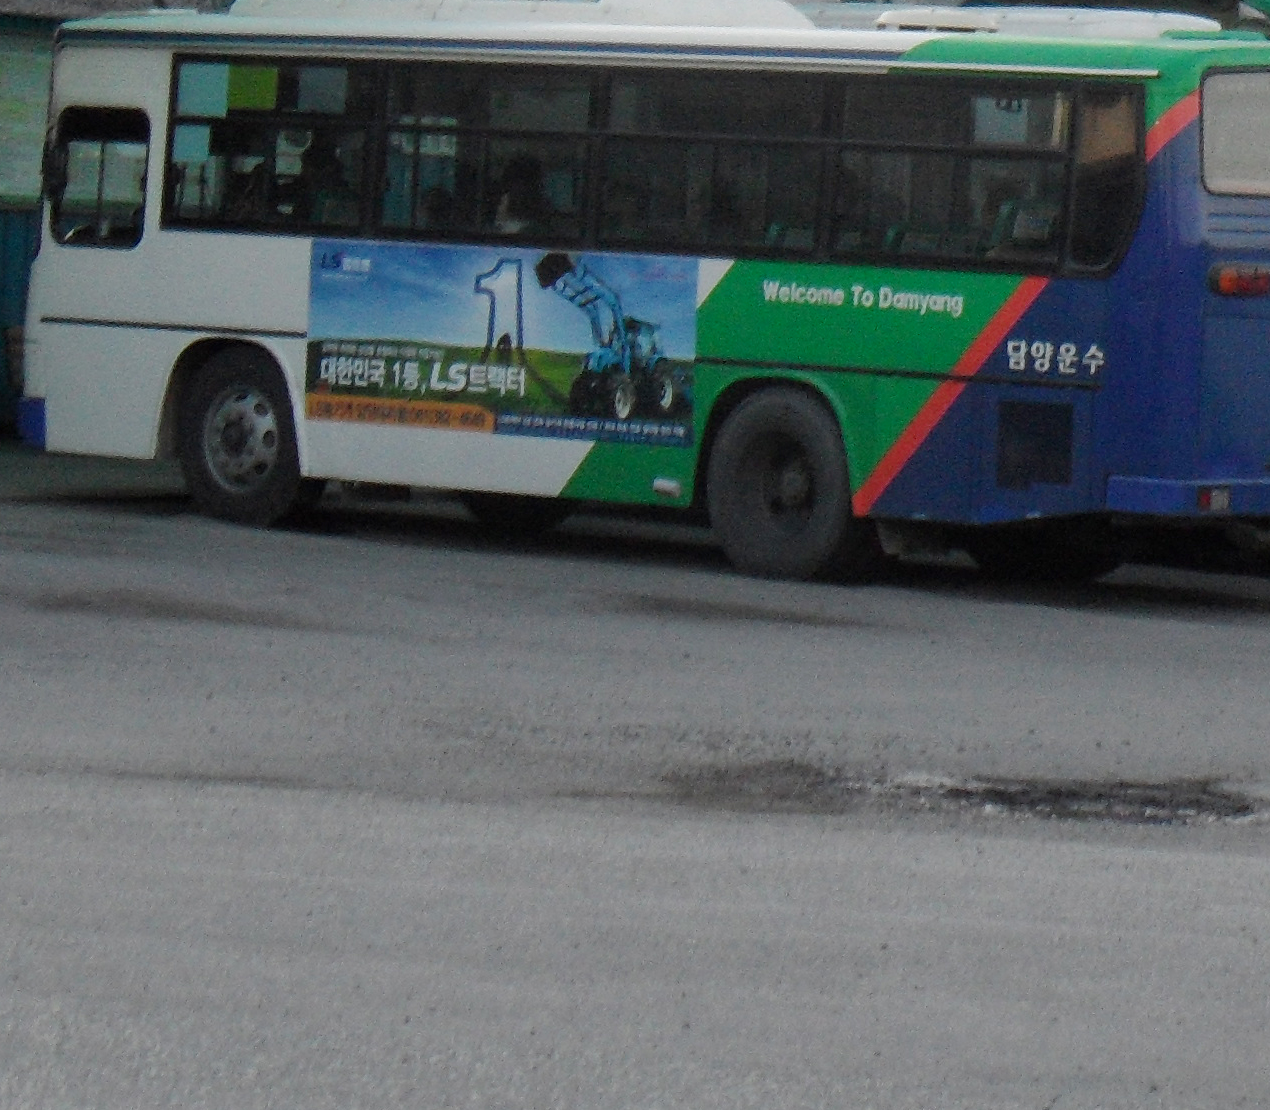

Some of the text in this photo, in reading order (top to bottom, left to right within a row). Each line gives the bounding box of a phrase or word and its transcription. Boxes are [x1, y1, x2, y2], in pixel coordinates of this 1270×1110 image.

[763, 278, 964, 318] Welcome To Damyang
[319, 356, 386, 388] 대한민국
[1006, 338, 1106, 376] 담양운수
